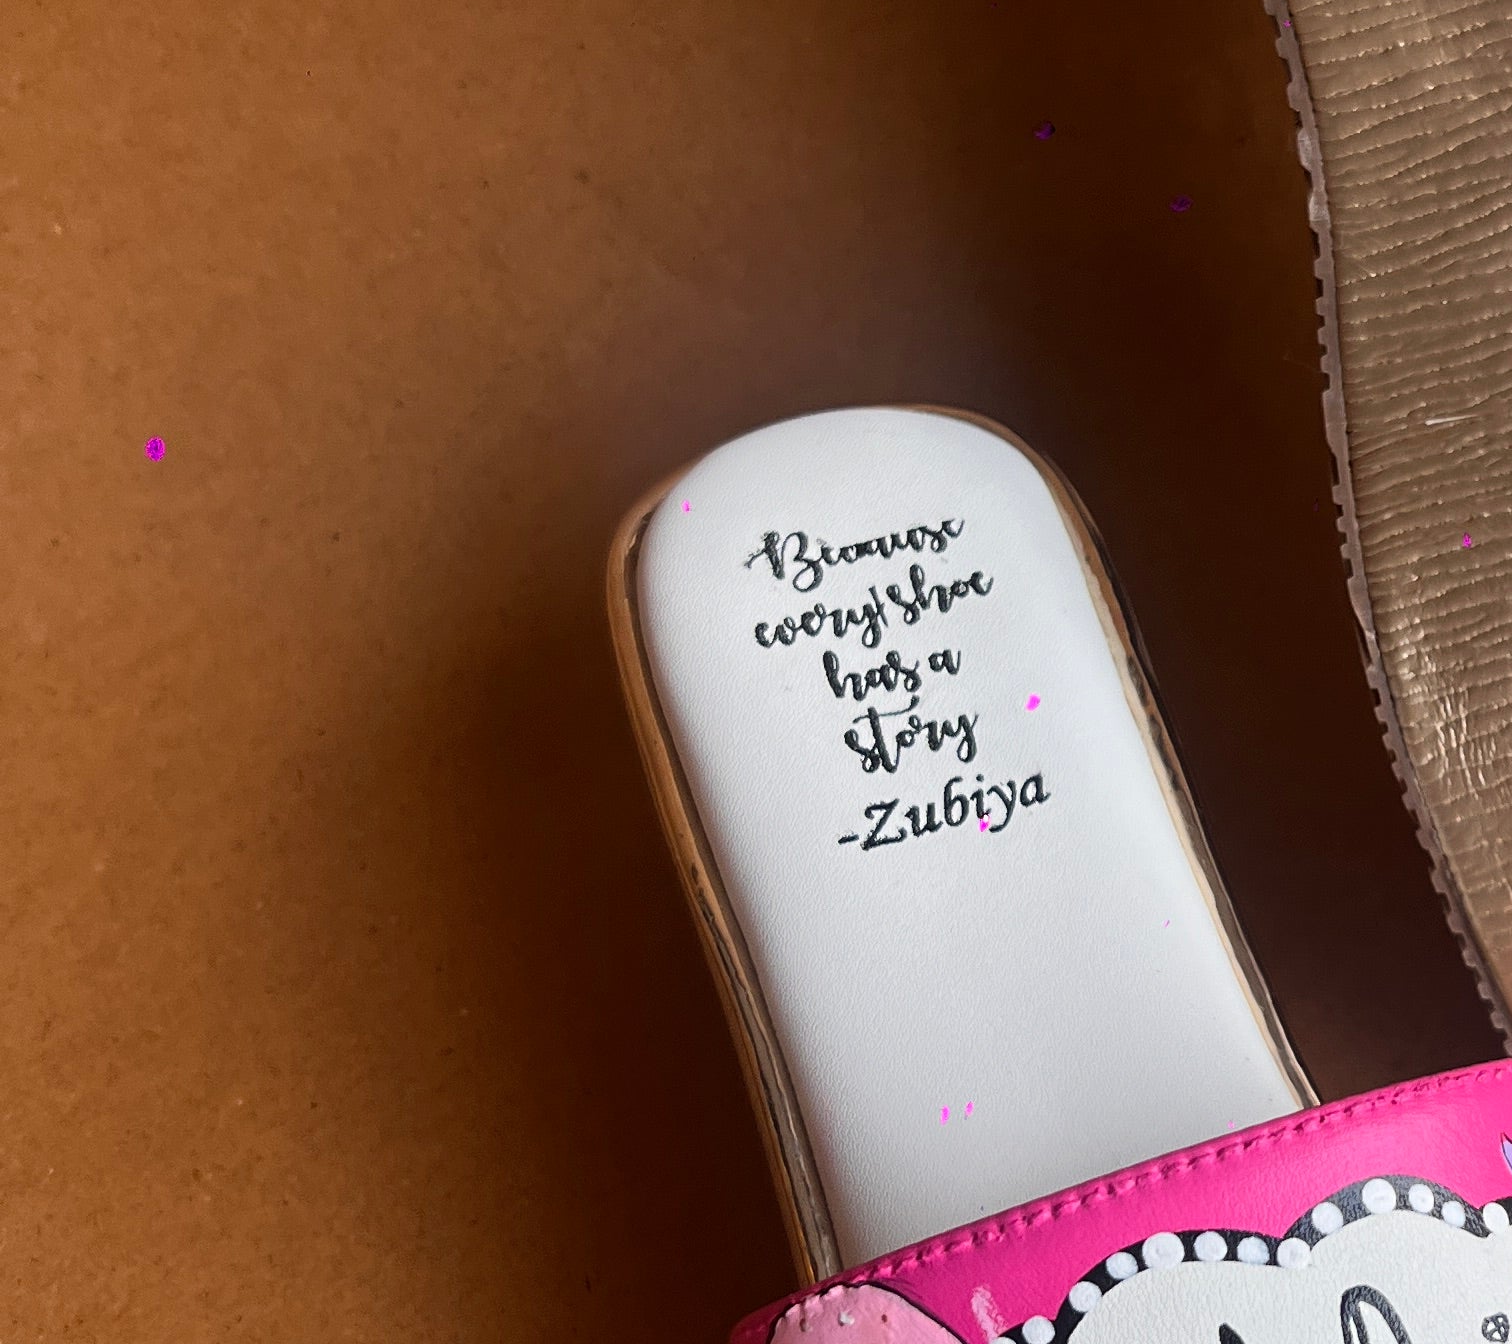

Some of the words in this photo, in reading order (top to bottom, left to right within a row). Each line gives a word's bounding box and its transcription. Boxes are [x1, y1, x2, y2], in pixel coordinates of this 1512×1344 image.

[743, 517, 965, 593] Because
[885, 563, 995, 625] shoe
[822, 650, 922, 702] has
[927, 648, 962, 676] a
[843, 695, 980, 774] story
[837, 771, 1052, 851] -Zubiya
